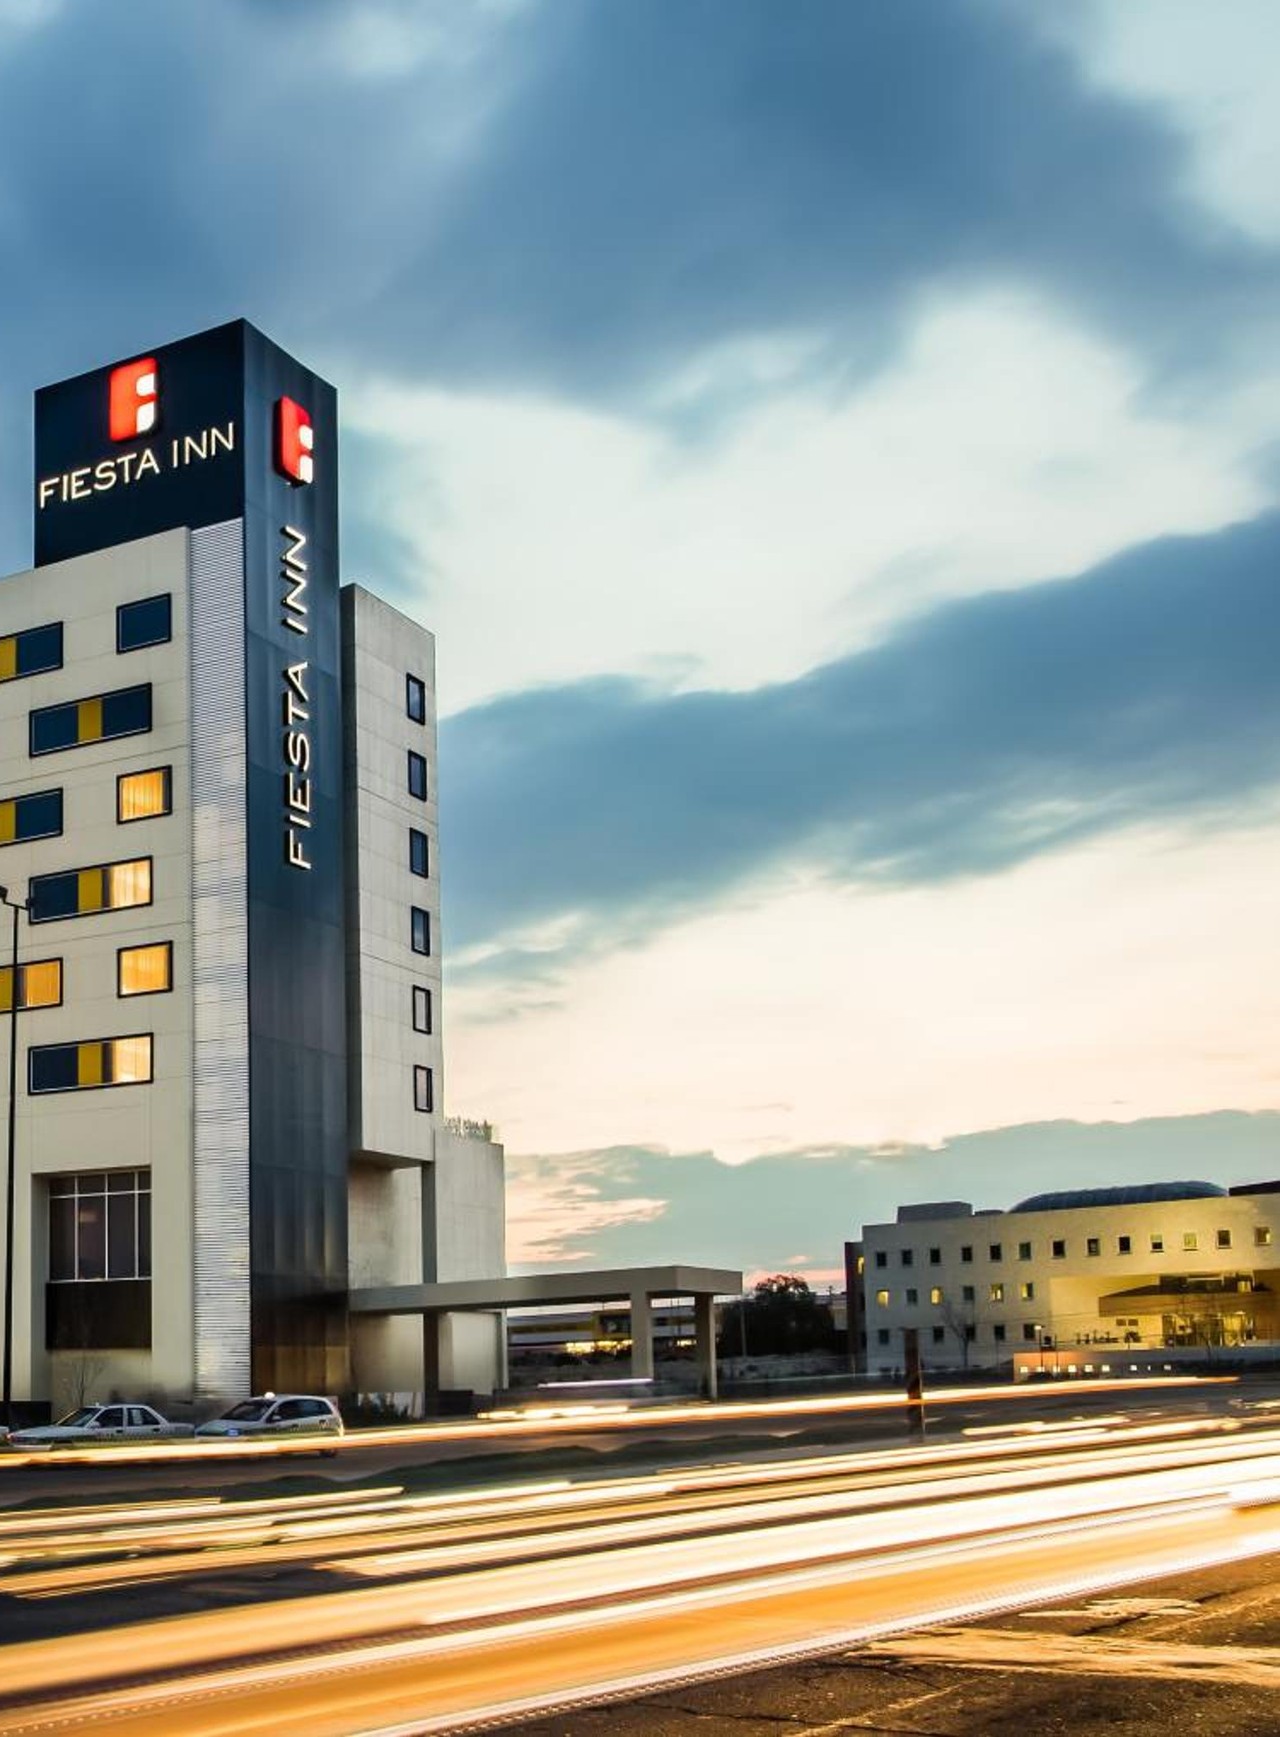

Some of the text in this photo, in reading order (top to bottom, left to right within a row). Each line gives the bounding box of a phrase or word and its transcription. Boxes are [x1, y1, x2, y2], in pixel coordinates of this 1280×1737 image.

[39, 421, 234, 509] FIESTA INN
[284, 524, 312, 870] FIESTA INN
